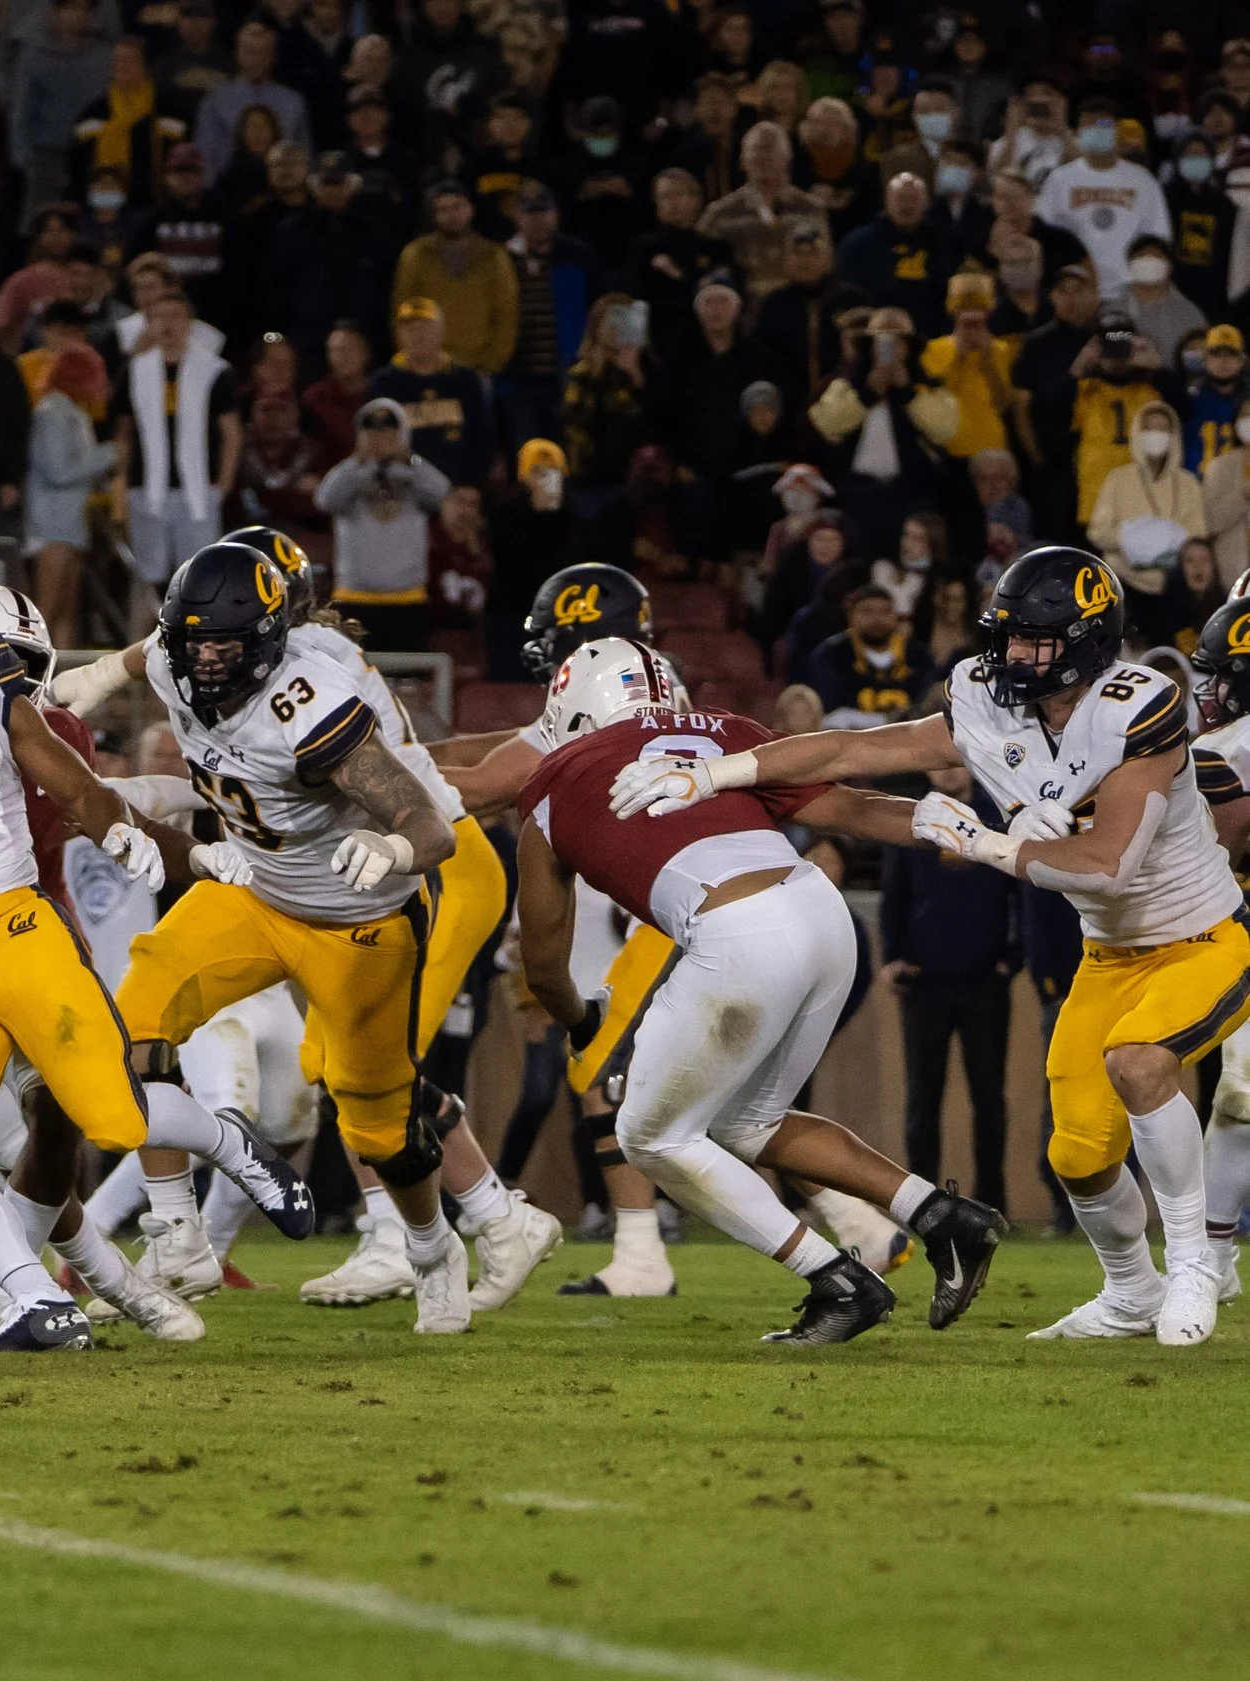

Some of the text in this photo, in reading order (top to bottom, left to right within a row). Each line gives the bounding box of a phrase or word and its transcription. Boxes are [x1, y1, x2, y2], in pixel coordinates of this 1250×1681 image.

[554, 584, 603, 627] Cal
[1074, 566, 1118, 619] Cal
[1100, 668, 1152, 703] 85
[269, 676, 316, 725] 63
[673, 713, 727, 736] FOX
[201, 747, 223, 771] Cal
[1039, 780, 1065, 801] Cal
[7, 911, 38, 937] Cal
[350, 926, 382, 946] Cal
